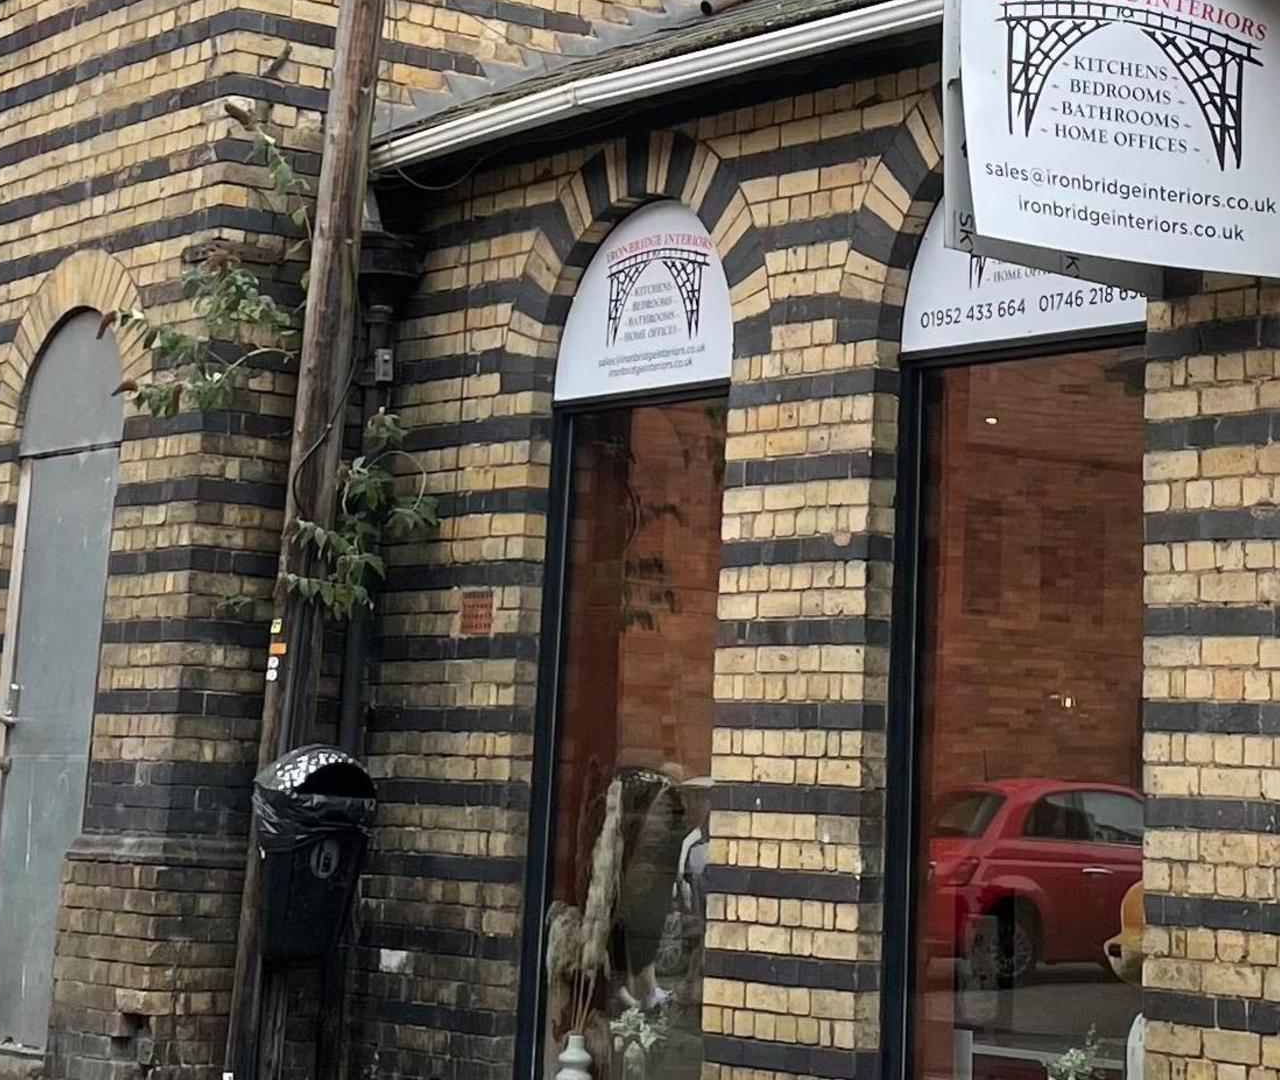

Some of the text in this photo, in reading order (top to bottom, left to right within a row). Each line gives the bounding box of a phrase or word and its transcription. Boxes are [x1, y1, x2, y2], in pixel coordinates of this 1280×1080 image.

[1073, 55, 1168, 81] KITCHENS
[1069, 79, 1172, 105] BEDROOMS
[1061, 101, 1180, 129] BATHROOMS
[1054, 123, 1188, 154] HOME OFFICES
[985, 160, 1277, 215] sales@ironbridgeinteriors.co.uk
[1018, 195, 1245, 242] ironbridgeinteriors.co.uk
[663, 233, 712, 249] INTERIORS
[993, 269, 1021, 283] HOME
[920, 309, 962, 329] 01952
[966, 302, 993, 322] 433
[997, 298, 1026, 318] 664
[1038, 289, 1084, 312] 01746
[1088, 286, 1114, 306] 218
